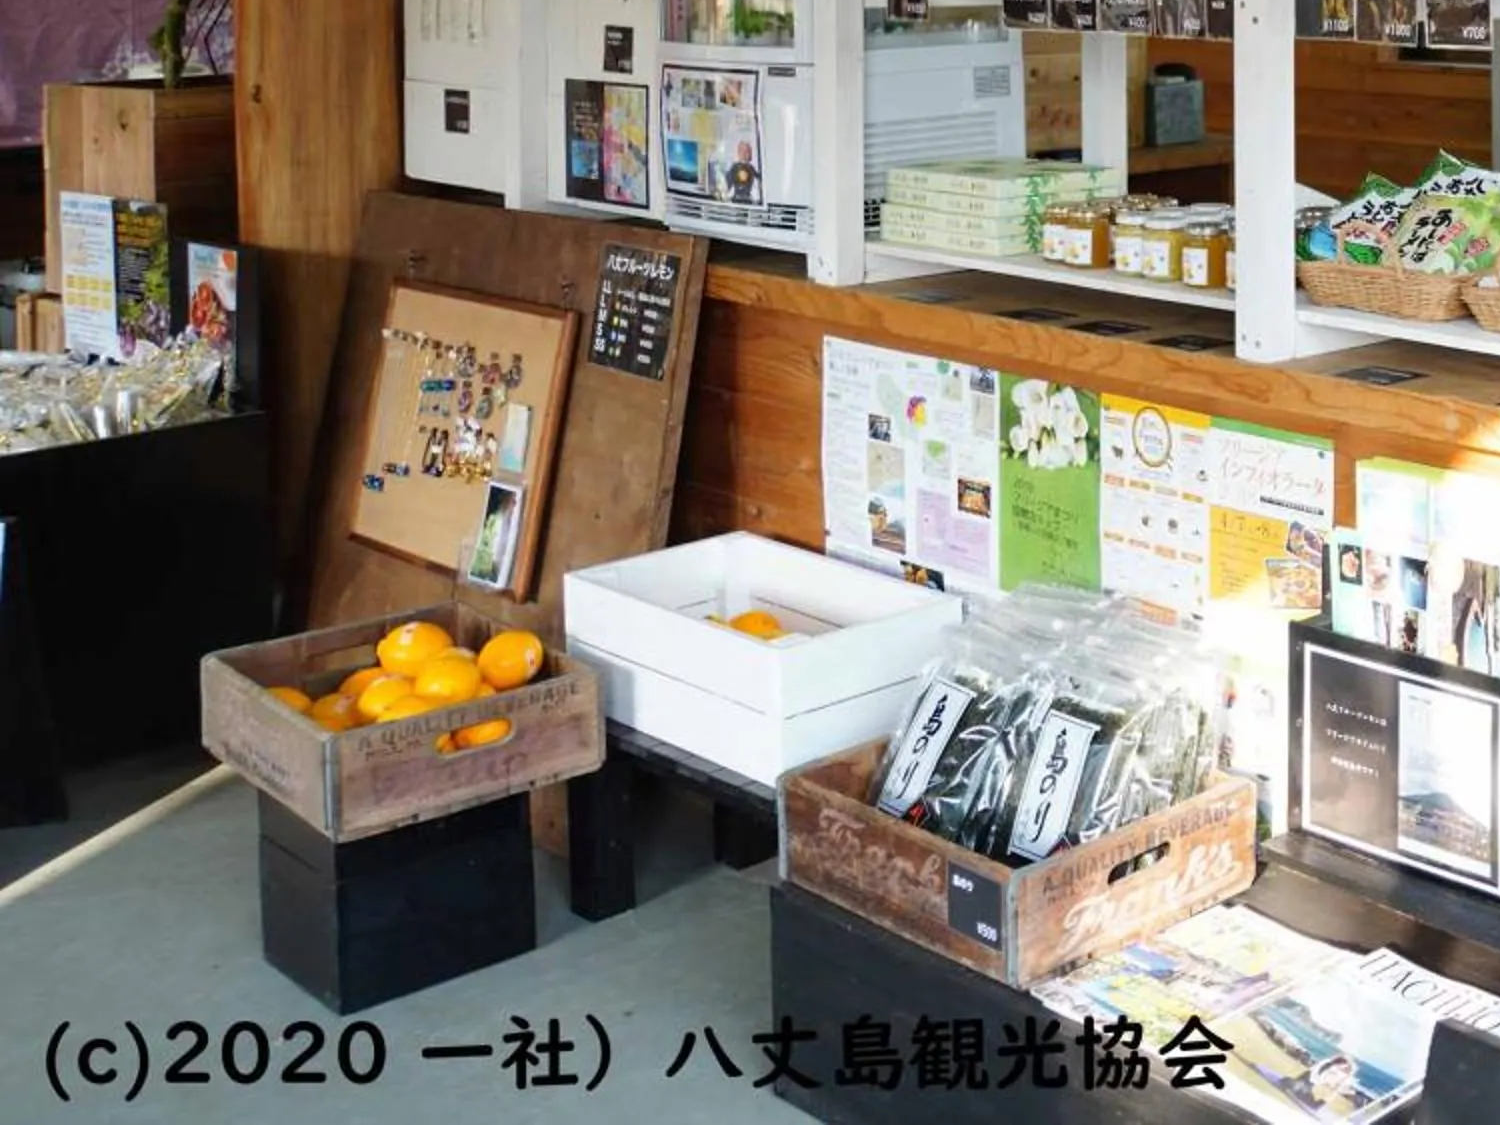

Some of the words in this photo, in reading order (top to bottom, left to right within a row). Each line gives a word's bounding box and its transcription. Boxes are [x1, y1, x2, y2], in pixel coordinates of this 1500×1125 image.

[896, 693, 949, 800] 島のり
[1030, 727, 1070, 844] 島のり
